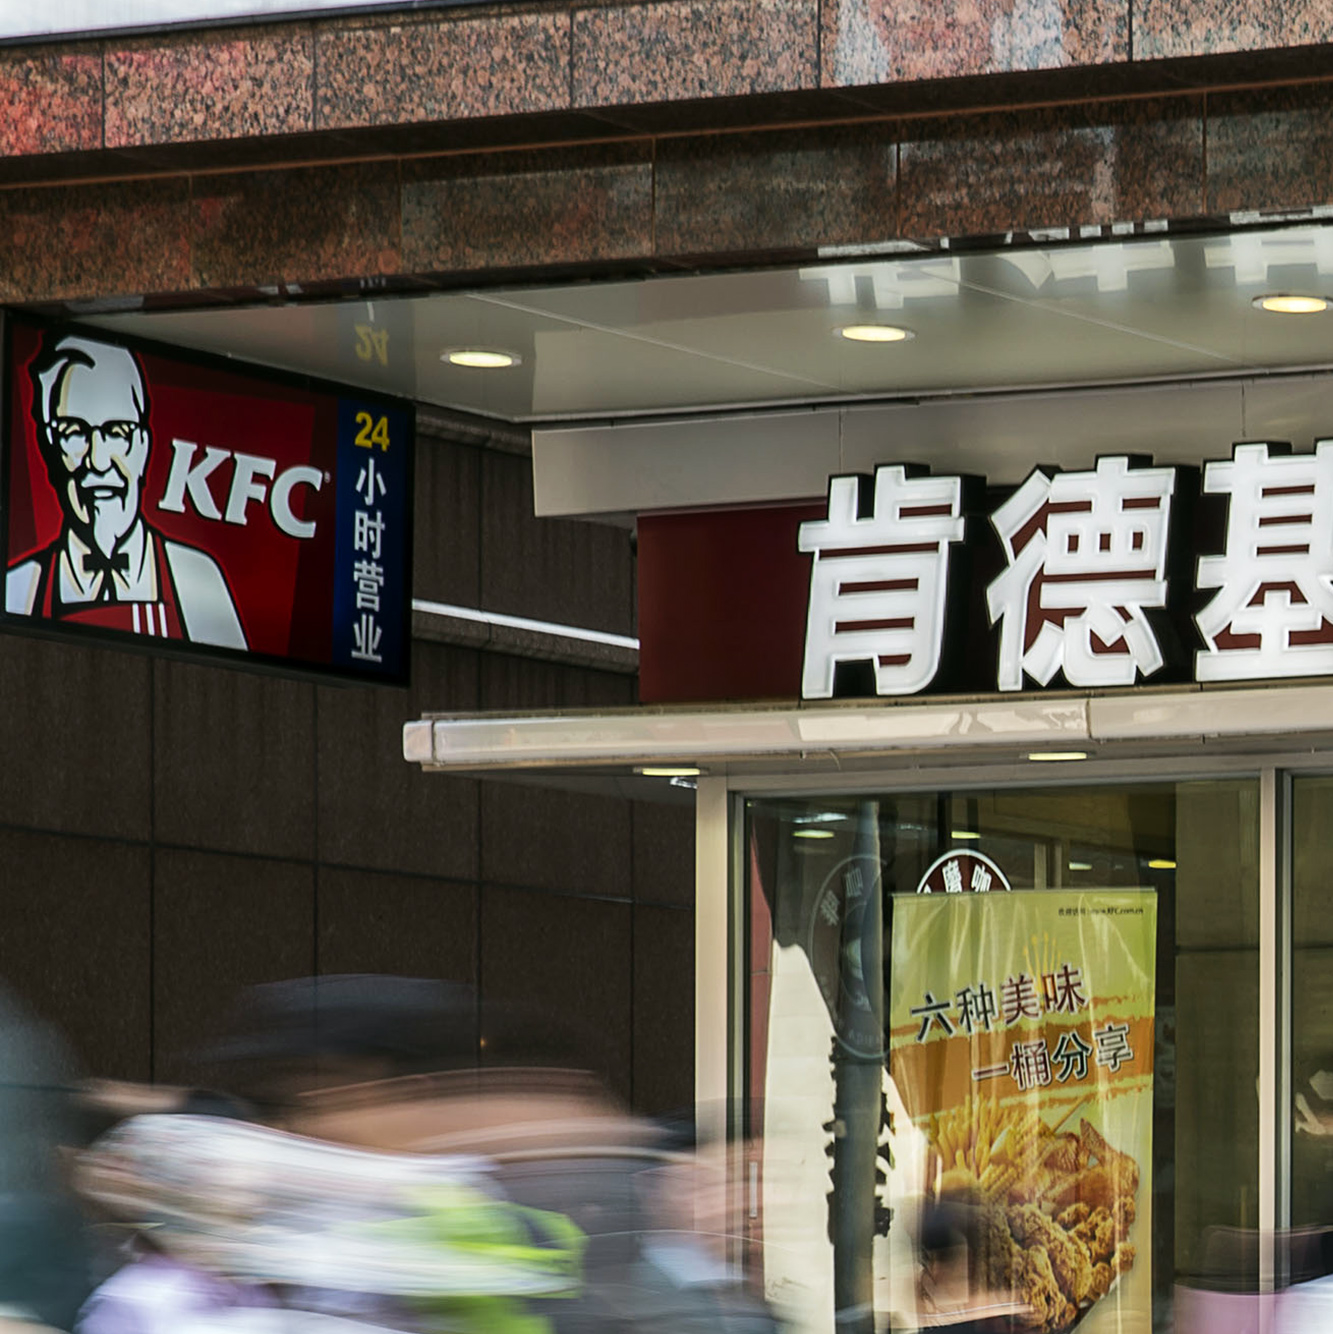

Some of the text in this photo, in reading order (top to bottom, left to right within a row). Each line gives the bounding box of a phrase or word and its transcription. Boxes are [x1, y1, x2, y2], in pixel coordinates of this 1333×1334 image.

[158, 438, 323, 539] KFC
[910, 963, 1089, 1044] 六种美味
[971, 1021, 1135, 1091] 一桶分享
